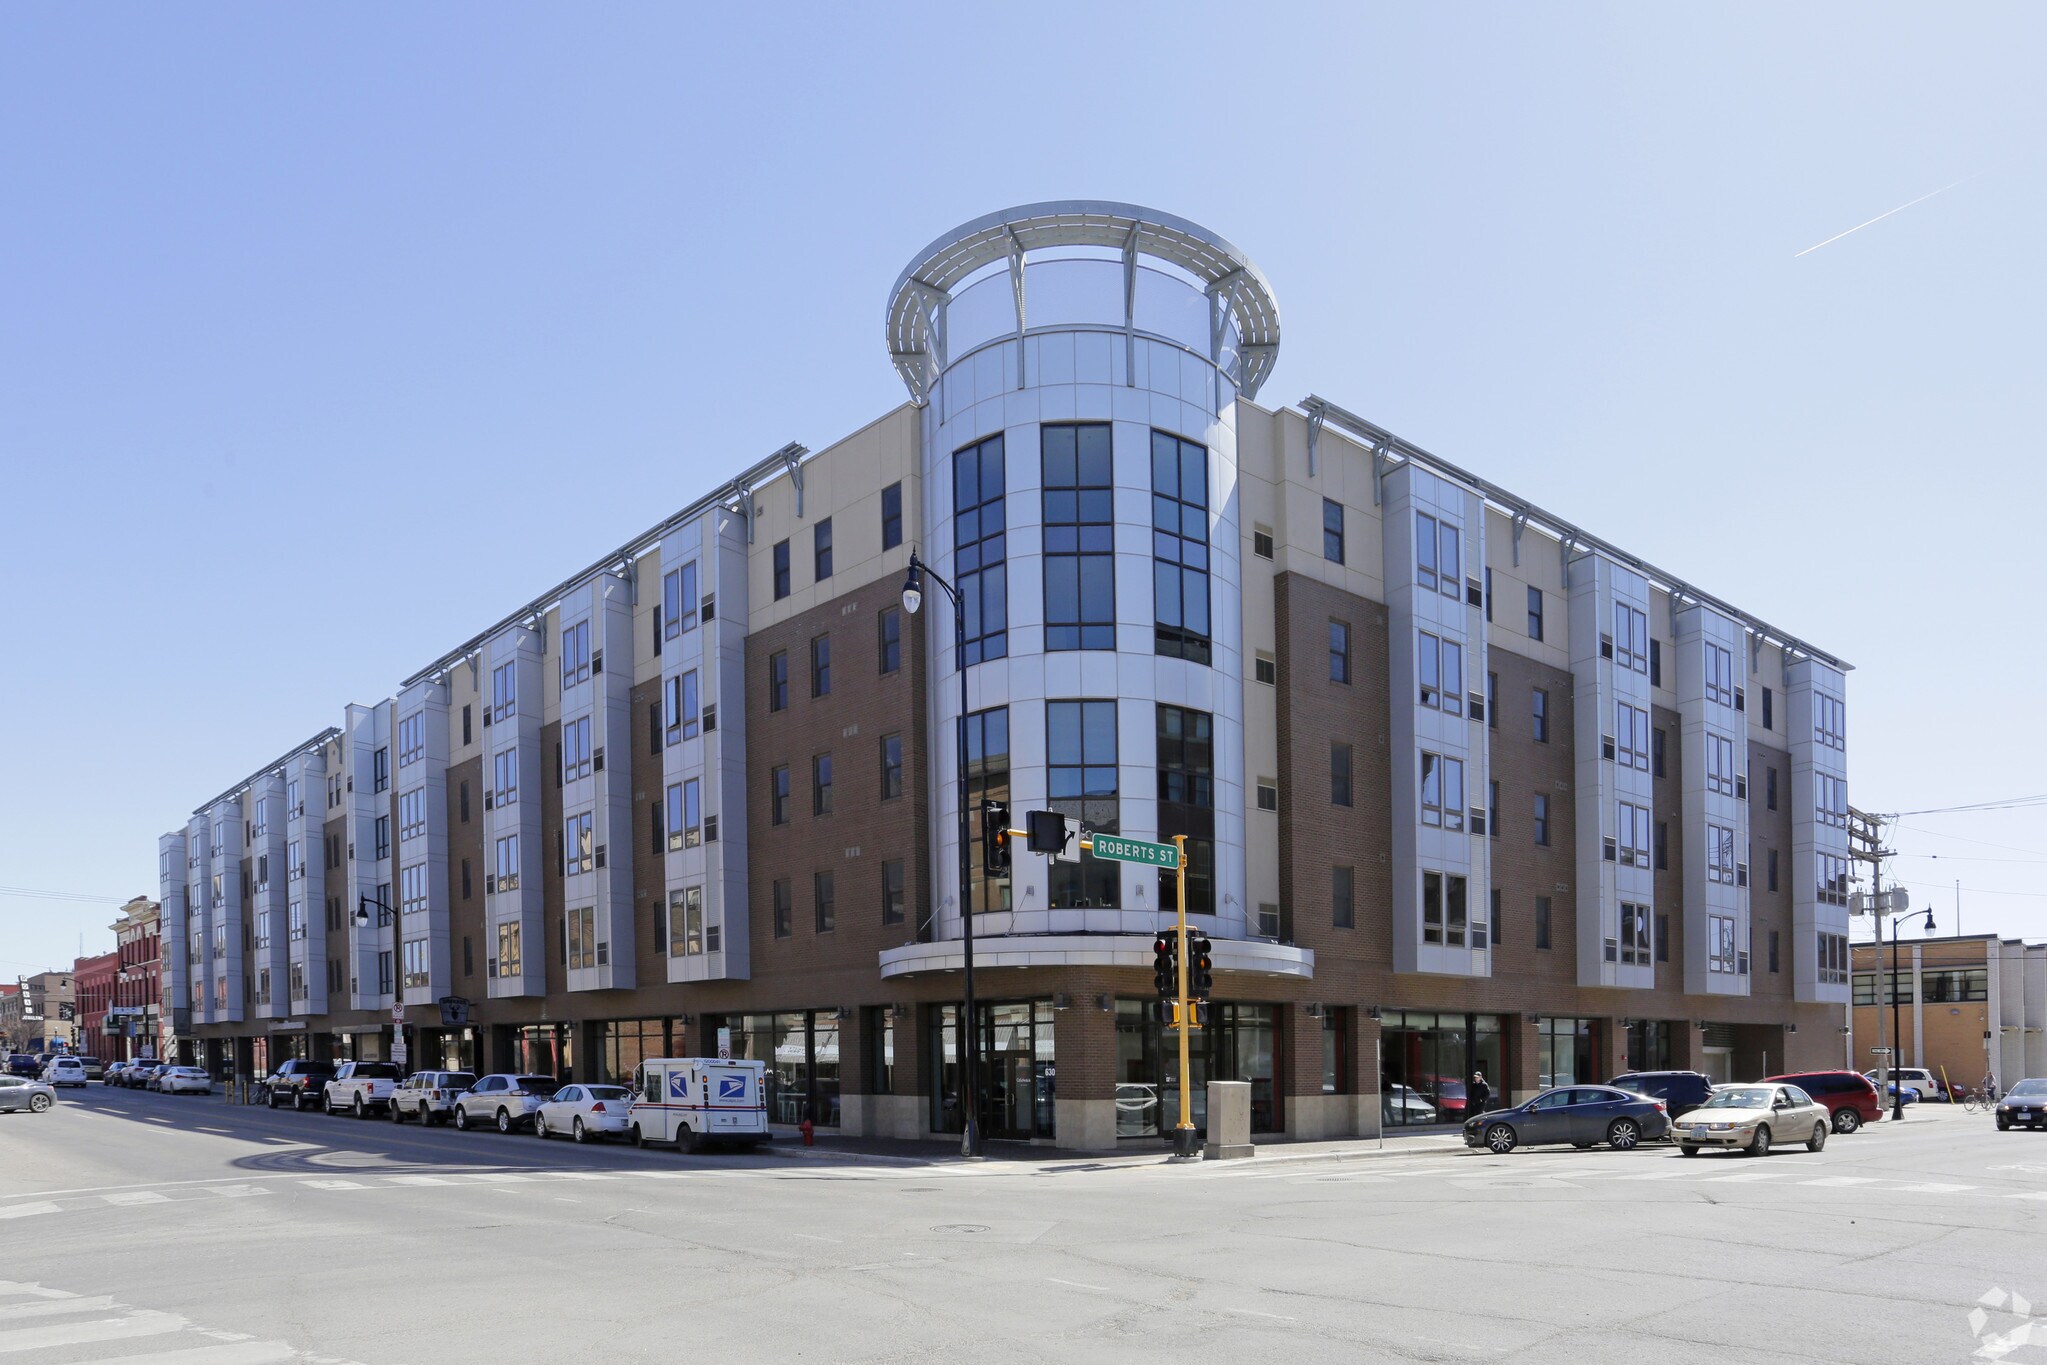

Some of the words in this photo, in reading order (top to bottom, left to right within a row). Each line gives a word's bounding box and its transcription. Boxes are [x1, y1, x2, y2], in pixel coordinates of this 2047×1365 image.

[1099, 840, 1155, 860] ROBERTS
[1160, 849, 1173, 863] ST
[1044, 1067, 1056, 1077] 630
